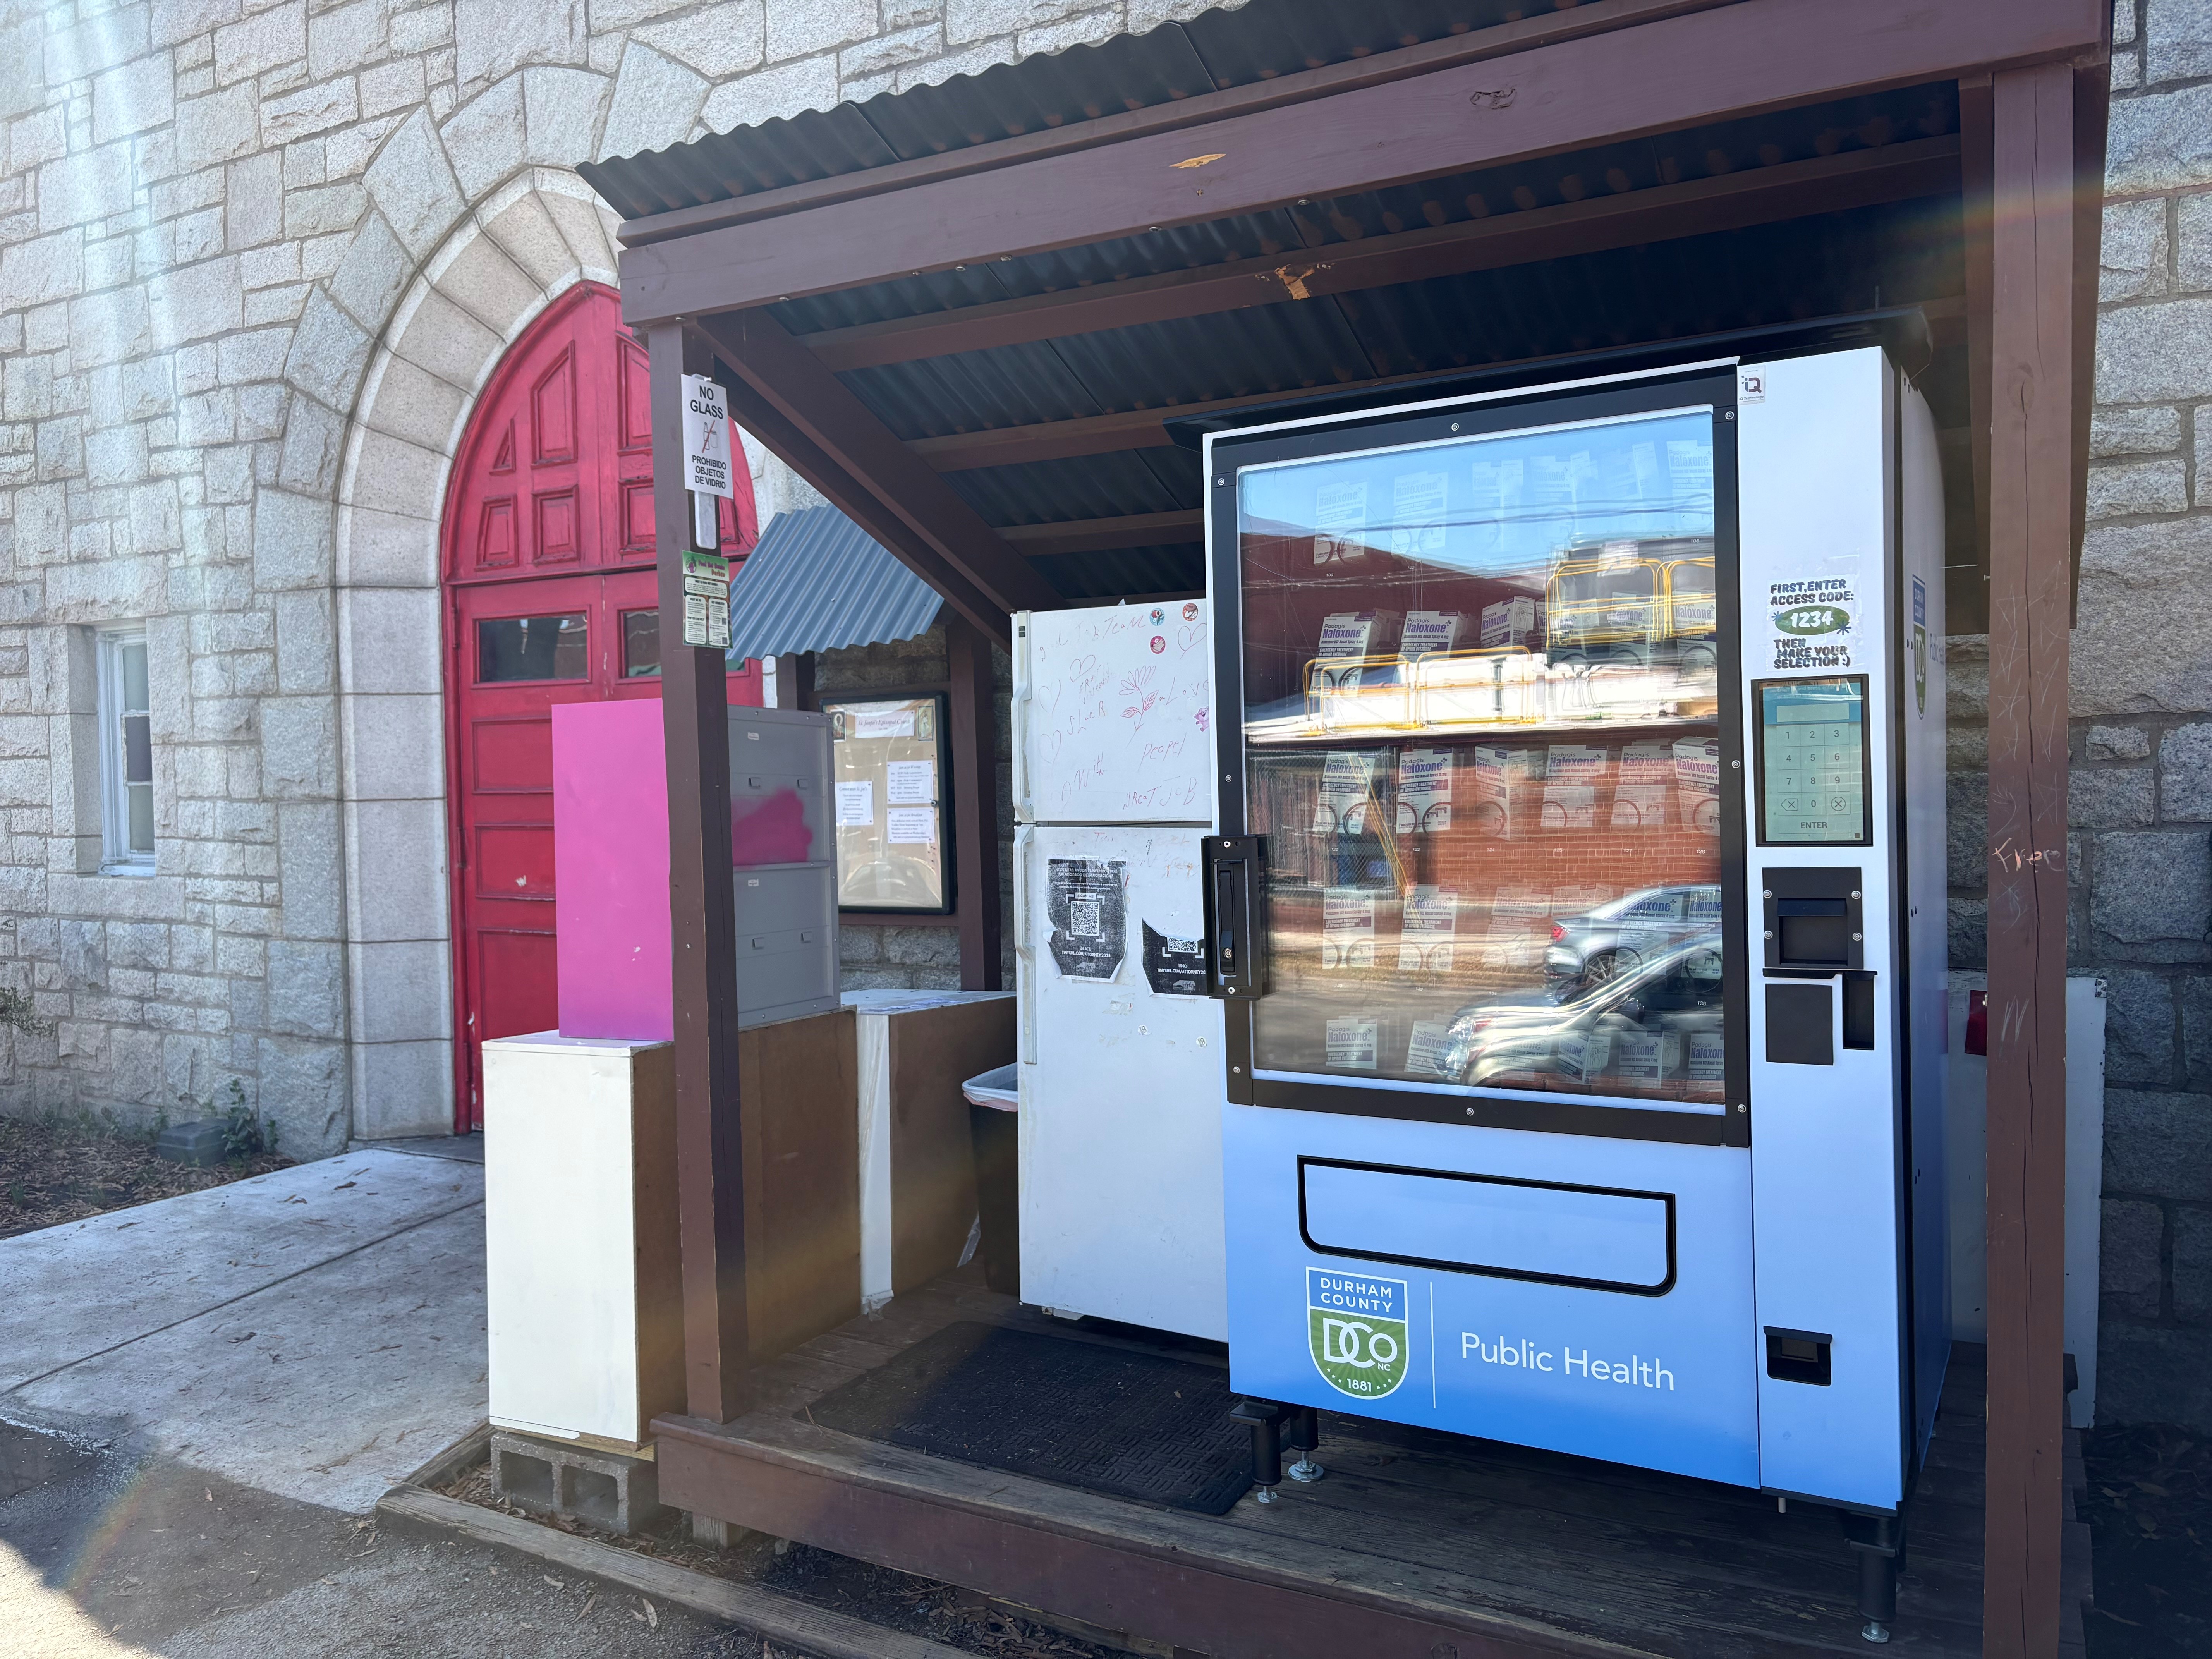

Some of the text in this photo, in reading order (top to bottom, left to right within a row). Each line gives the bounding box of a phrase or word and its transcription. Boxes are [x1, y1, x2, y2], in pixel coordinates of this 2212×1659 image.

[699, 386, 713, 400] NO
[690, 400, 723, 419] GLASS
[692, 455, 726, 470] PROHIBIDO
[1670, 456, 1709, 467] Naloxone
[695, 466, 725, 479] OBJETOS
[706, 477, 726, 489] VIDRIO
[1770, 591, 1854, 606] ACCESS CODE:
[1675, 606, 1712, 619] Naloxone
[1790, 610, 1834, 628] 1234
[1406, 623, 1446, 633] Naloxone
[1482, 613, 1508, 630] Naloxone
[1322, 629, 1361, 639] Naloxone
[1774, 638, 1806, 649] THEN
[1777, 645, 1848, 659] MAKE YOUR
[1774, 656, 1839, 669] SELECTION
[1476, 755, 1490, 763] Padagis
[1550, 757, 1595, 767] Naloxone
[1623, 757, 1669, 767] Naloxone
[1675, 753, 1698, 761] Padagis
[1326, 763, 1364, 773] Naloxone
[1401, 762, 1442, 775] Naloxone
[1477, 760, 1502, 776] Naloxone
[1676, 759, 1718, 774] Naloxone
[1992, 837, 2064, 873] Free
[1326, 899, 1365, 910] Naloxone
[1406, 900, 1447, 910] Naloxone
[1328, 1032, 1367, 1042] Naloxone
[1414, 1029, 1436, 1037] Padagis
[1412, 1034, 1452, 1050] Naloxone
[1621, 1044, 1654, 1056] Naloxone
[1321, 1277, 1392, 1298] DURHAM
[1321, 1293, 1393, 1312] COUNTY
[1378, 1363, 1390, 1371] NC
[1462, 1331, 1674, 1391] Public Health
[1347, 1378, 1372, 1392] 1881
